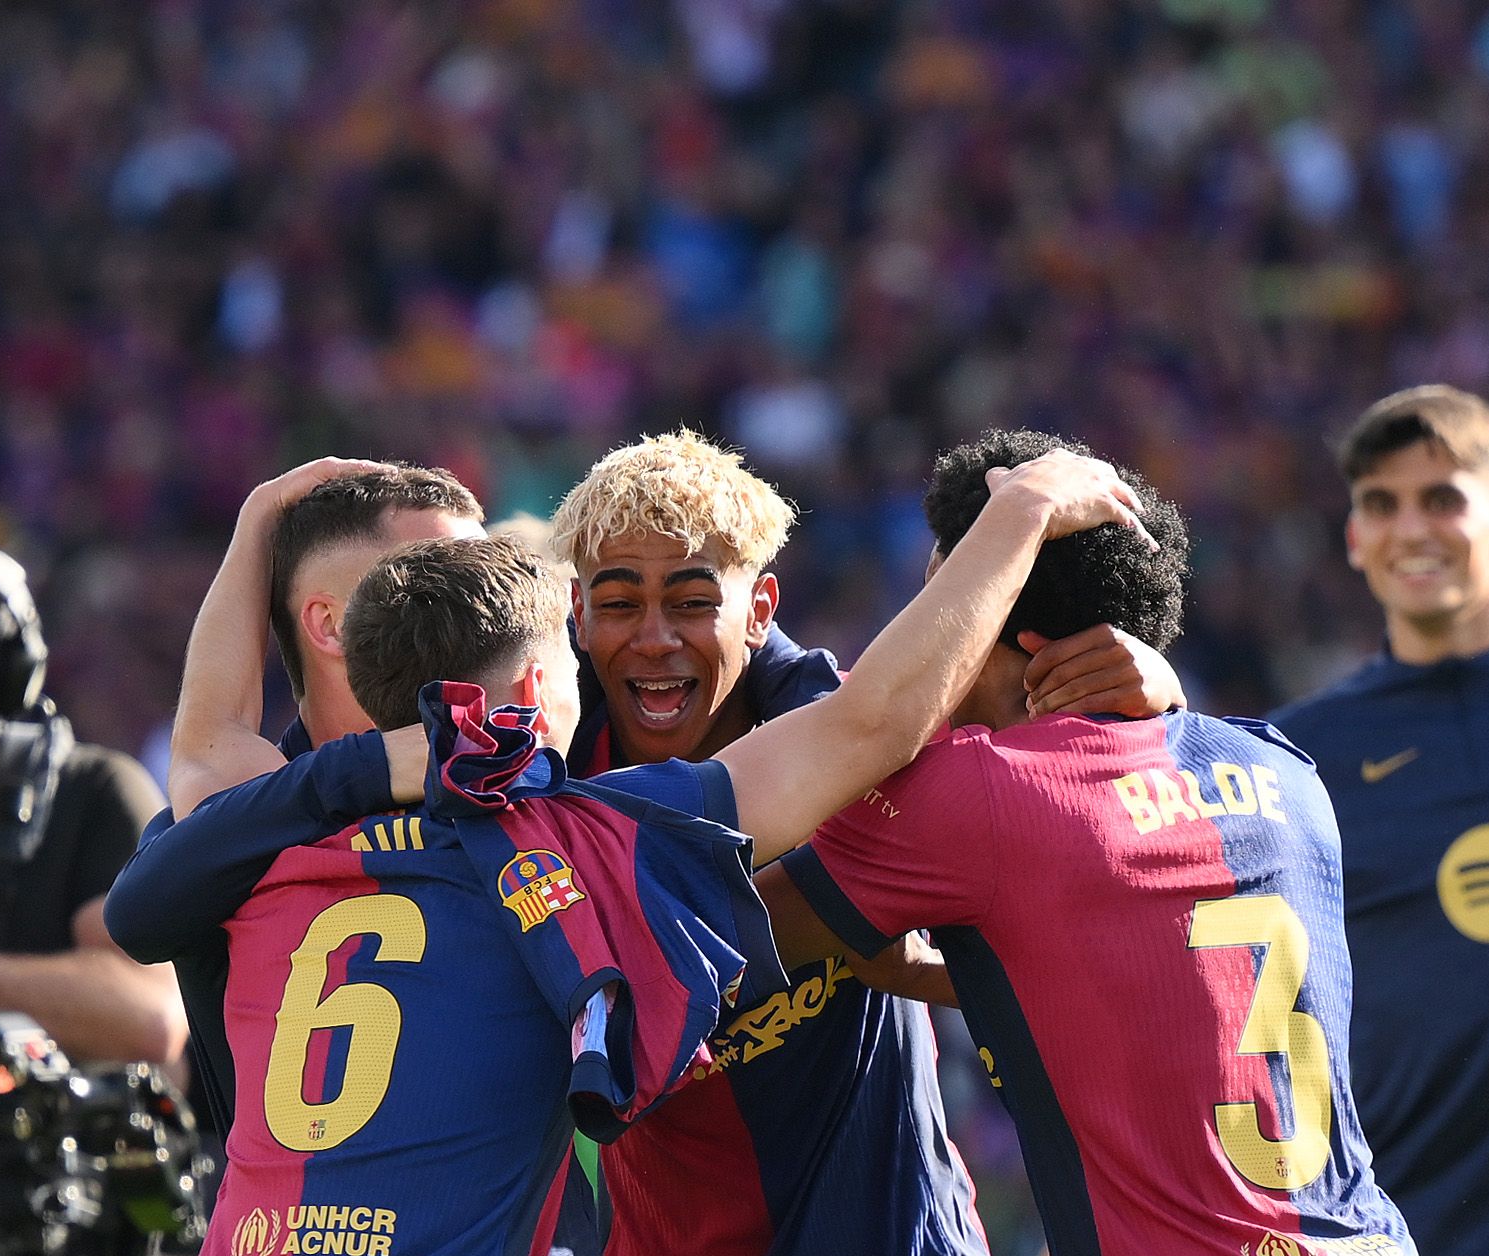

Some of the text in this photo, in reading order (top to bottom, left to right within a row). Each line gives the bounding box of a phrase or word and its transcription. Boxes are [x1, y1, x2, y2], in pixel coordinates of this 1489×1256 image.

[1113, 761, 1288, 835] BALDE
[262, 893, 428, 1153] 6
[1187, 893, 1332, 1191] 3
[285, 1205, 397, 1234] UNHCR
